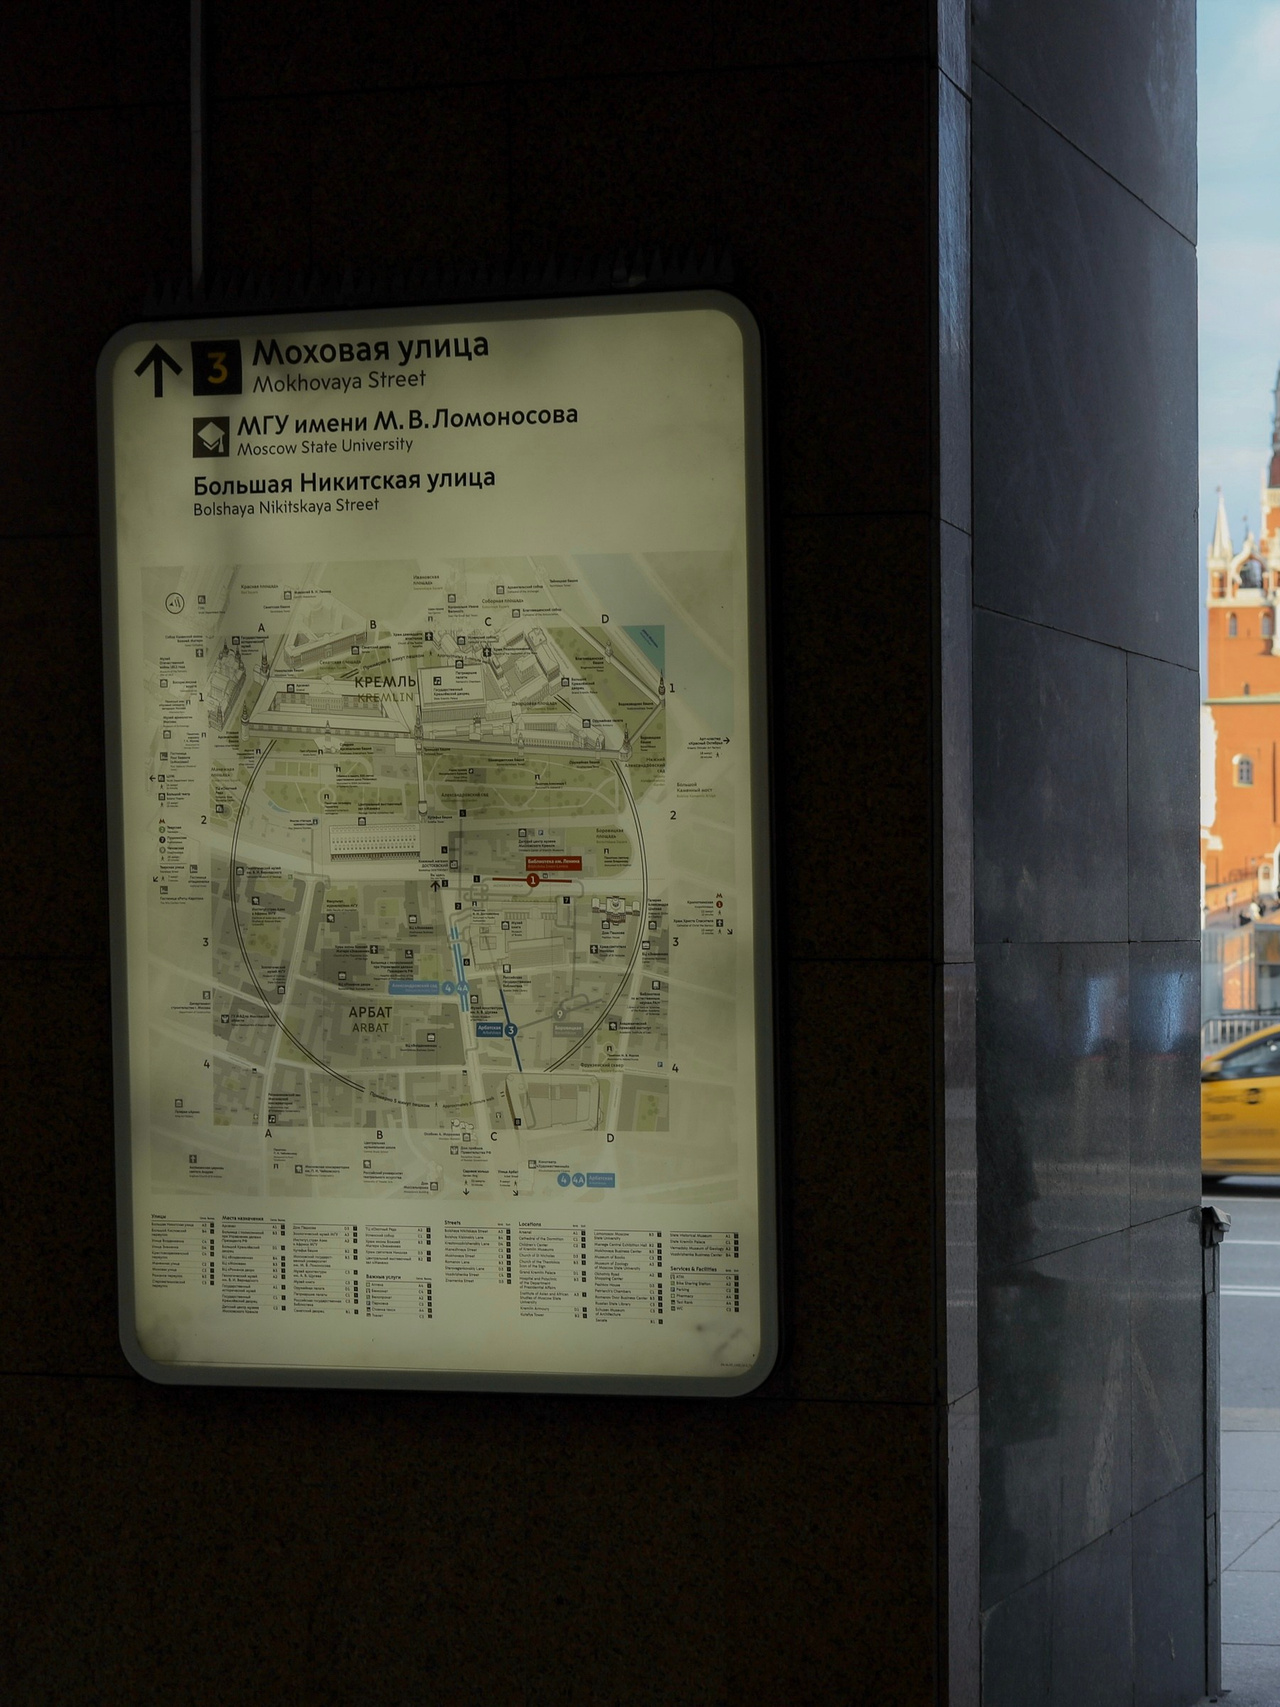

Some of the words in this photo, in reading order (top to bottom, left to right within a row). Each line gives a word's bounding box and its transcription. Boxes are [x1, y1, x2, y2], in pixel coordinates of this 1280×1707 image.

[252, 339, 390, 366] Моховая
[398, 336, 489, 366] улица
[207, 352, 228, 384] 3
[253, 374, 362, 393] Mokhovaya
[368, 370, 426, 388] Street
[237, 415, 289, 436] МГУ
[294, 414, 368, 434] имени
[237, 442, 297, 456] Moscow
[302, 440, 337, 454] State
[342, 438, 414, 453] University
[194, 476, 293, 496] Большая
[300, 473, 421, 493] Никитская
[427, 471, 495, 493] улица
[194, 503, 255, 518] Bolshaya
[259, 500, 332, 515] Nikitskaya
[336, 498, 379, 513] Street
[484, 617, 492, 627] C
[602, 614, 609, 624] D
[258, 623, 265, 633] A
[370, 620, 377, 629] B
[355, 676, 416, 688] КРЕМЛЬ
[669, 684, 675, 693] 1
[199, 692, 204, 702] 1
[358, 692, 414, 702] KREMLIN
[201, 816, 207, 824] 2
[670, 811, 676, 820] 2
[203, 937, 209, 947] 3
[673, 937, 679, 947] 3
[445, 984, 452, 992] 4
[349, 1007, 392, 1018] АРБАТ
[352, 1023, 389, 1033] ARBAT
[508, 1026, 514, 1034] 3
[204, 1060, 210, 1069] 4
[672, 1064, 679, 1073] 4
[265, 1129, 272, 1138] A
[377, 1130, 383, 1140] B
[490, 1131, 497, 1141] C
[606, 1133, 614, 1143] D
[561, 1176, 567, 1184] 4
